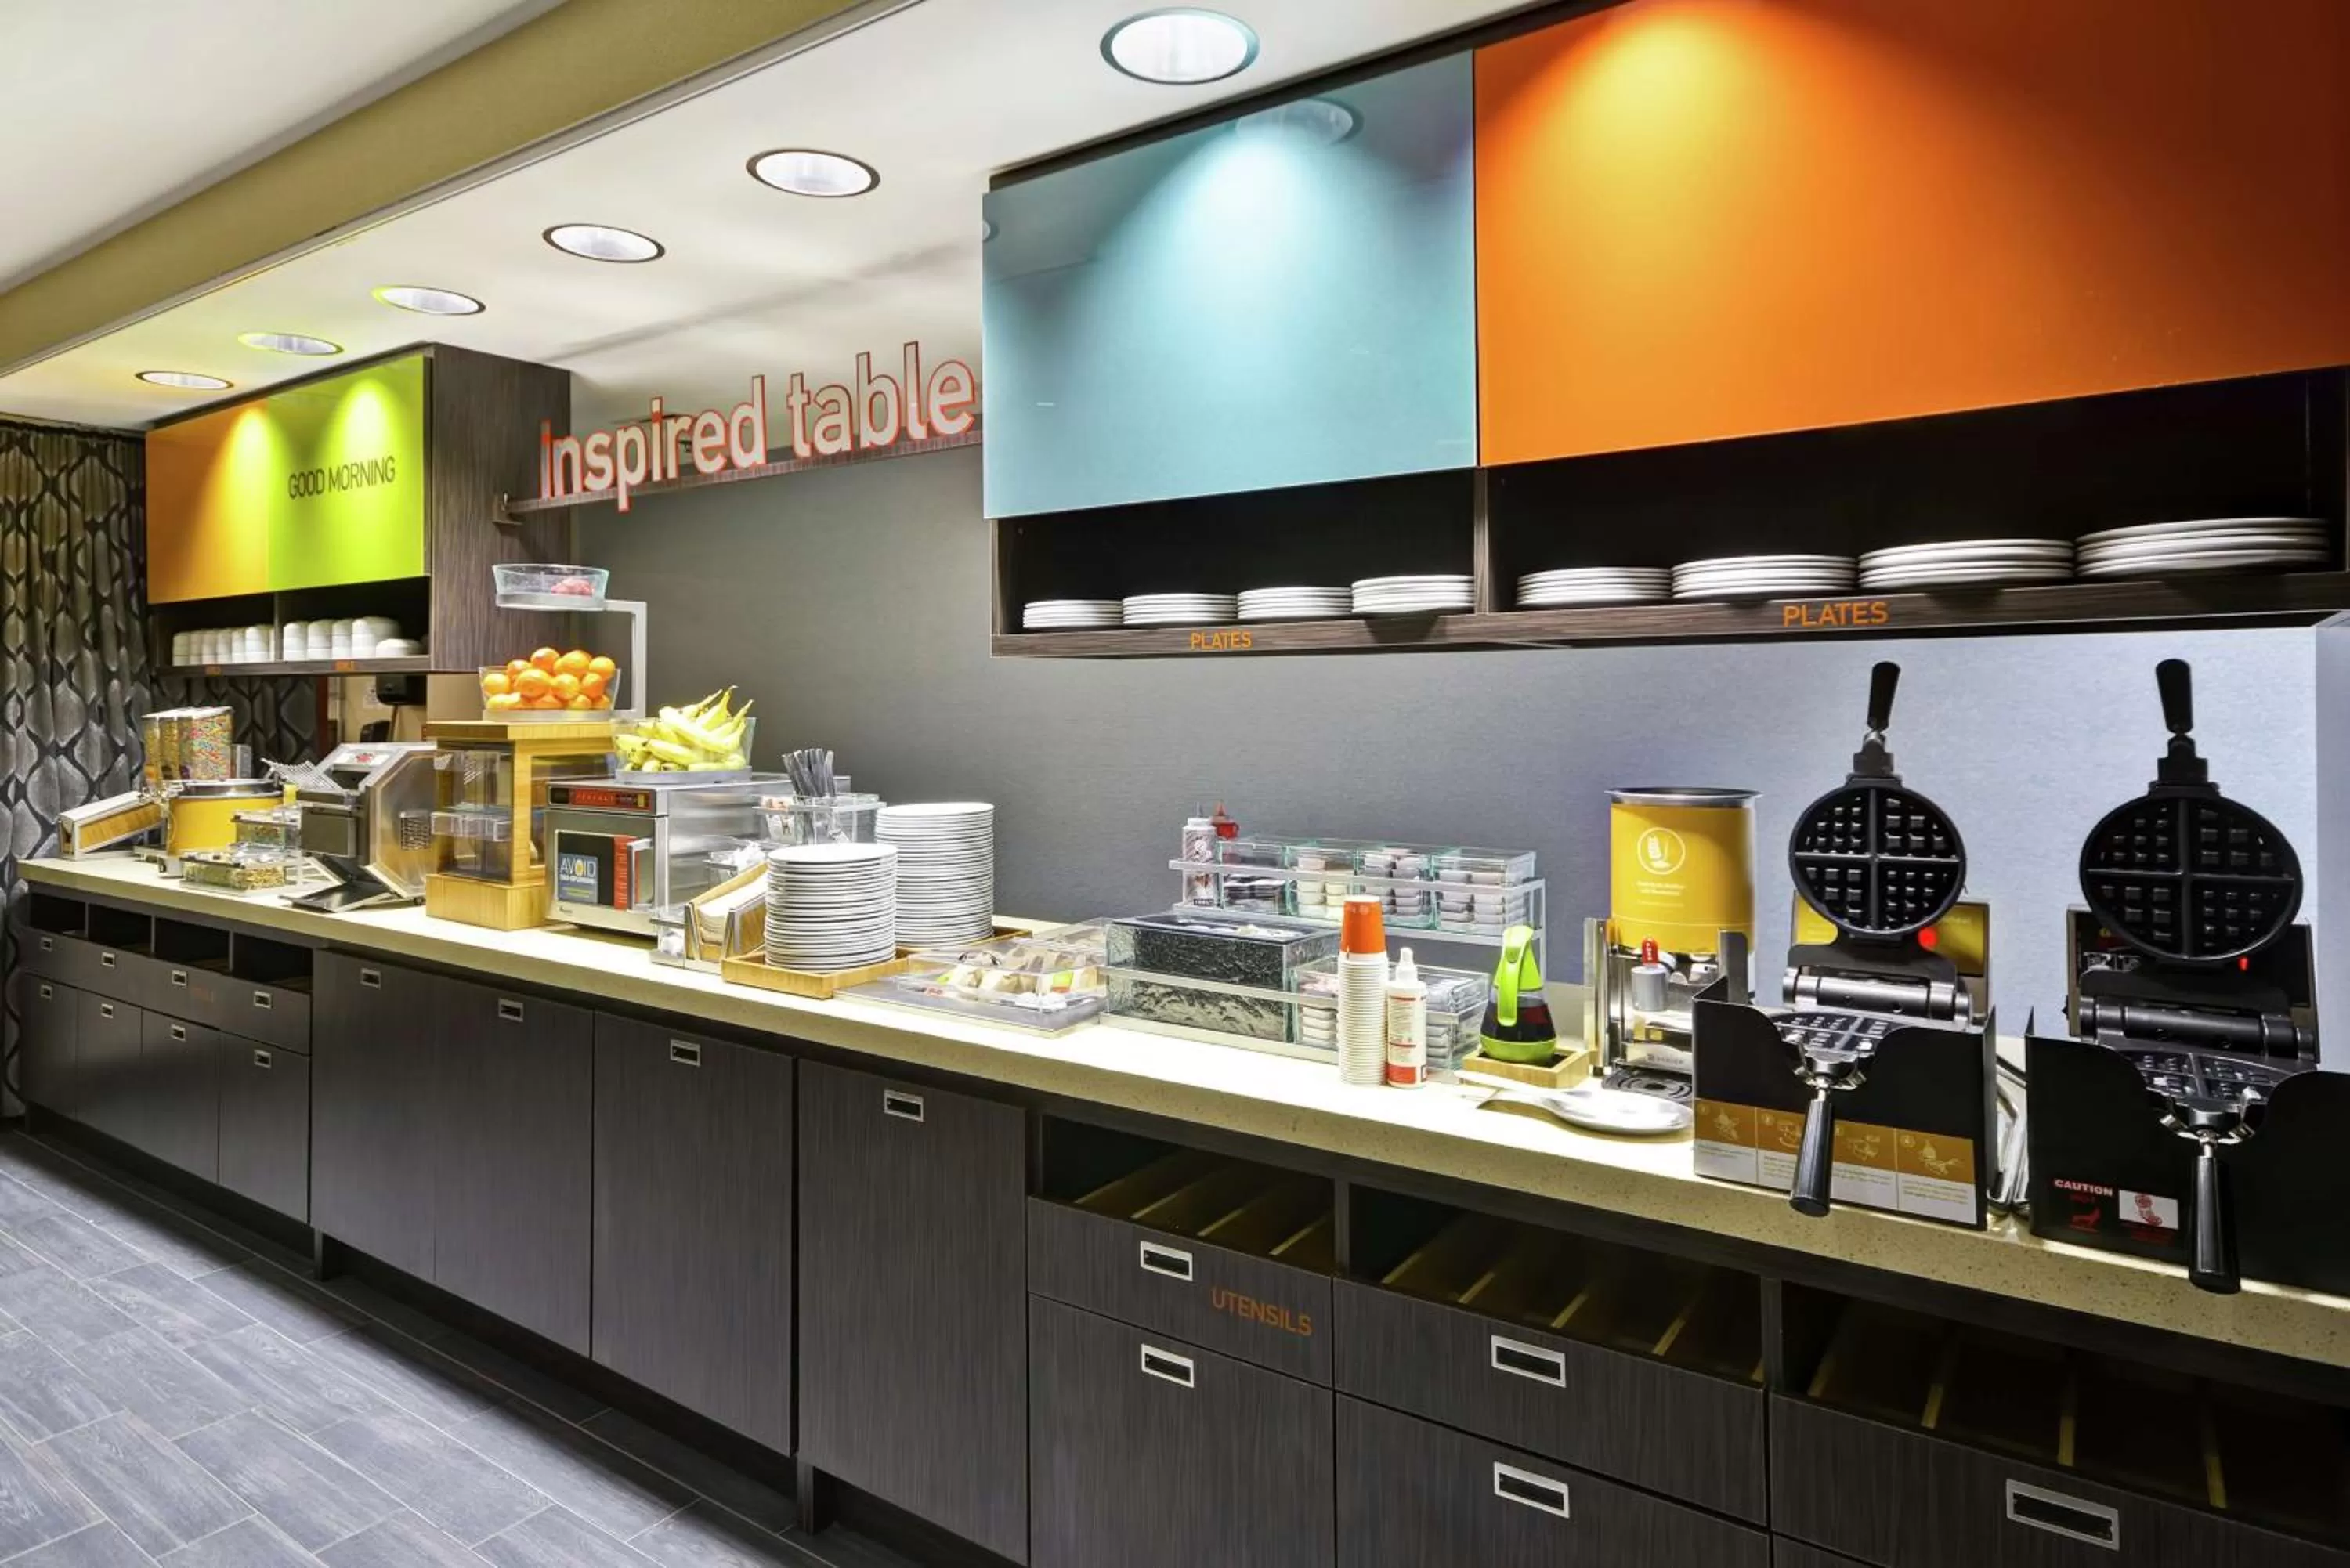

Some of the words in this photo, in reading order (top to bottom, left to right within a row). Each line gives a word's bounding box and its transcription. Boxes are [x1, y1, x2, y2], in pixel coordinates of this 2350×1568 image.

[540, 374, 767, 513] inspired
[786, 341, 976, 459] table
[288, 468, 325, 499] GOOD
[328, 455, 396, 492] MORNING
[1782, 601, 1889, 627] PLATES
[1190, 630, 1252, 650] PLATES
[559, 858, 597, 878] AVOID
[2053, 1178, 2113, 1197] CAUTION
[1210, 1285, 1313, 1336] UTENSILS
